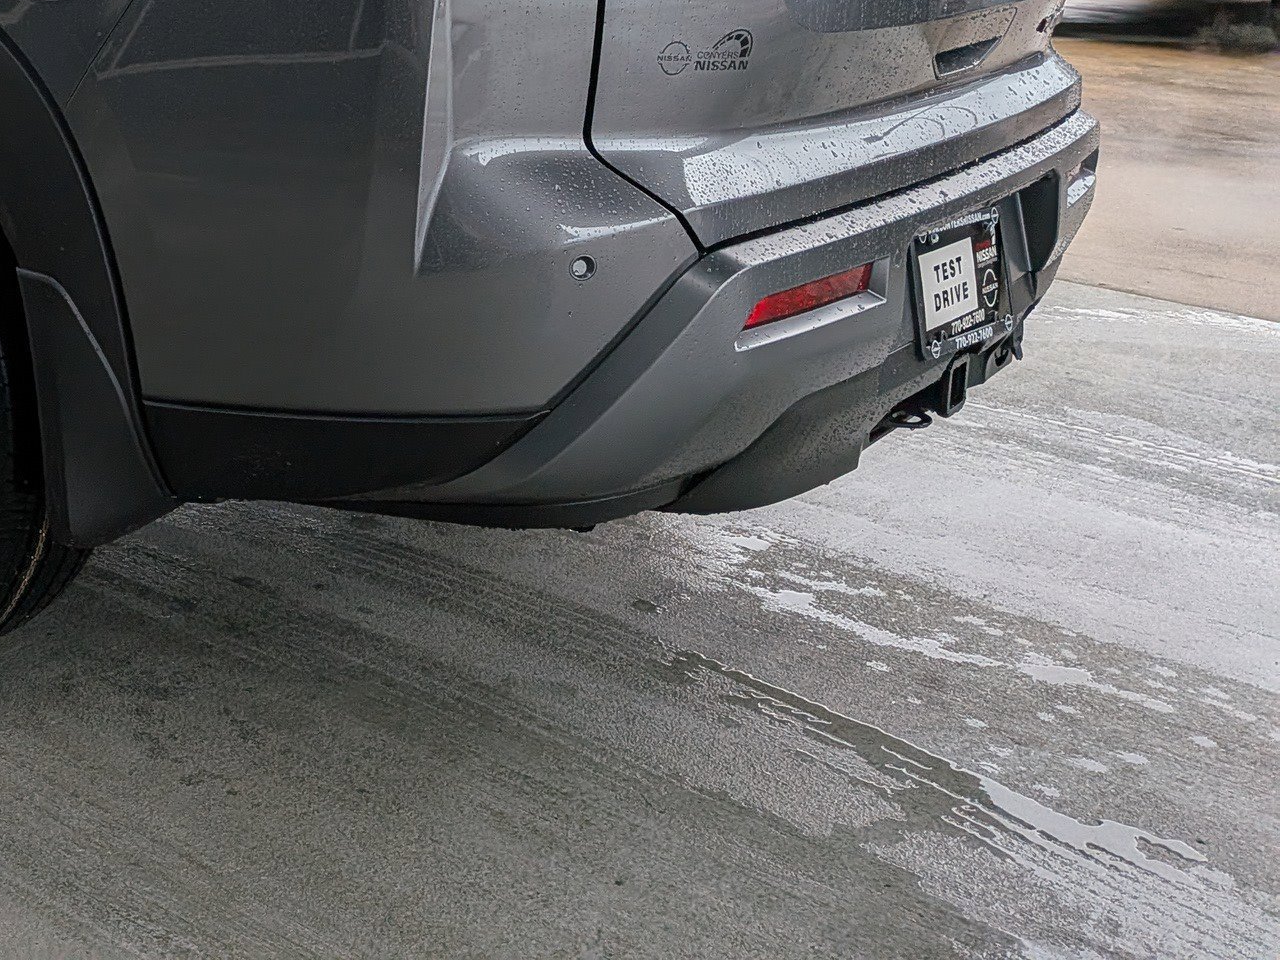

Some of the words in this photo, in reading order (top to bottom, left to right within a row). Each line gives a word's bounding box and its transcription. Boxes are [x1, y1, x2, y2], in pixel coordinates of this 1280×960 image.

[657, 54, 692, 62] NISSAN
[697, 50, 740, 61] CONYERS
[694, 59, 749, 72] NISSAN
[976, 245, 997, 263] NISSAN
[933, 256, 962, 284] TEST
[933, 281, 969, 312] DRIVE
